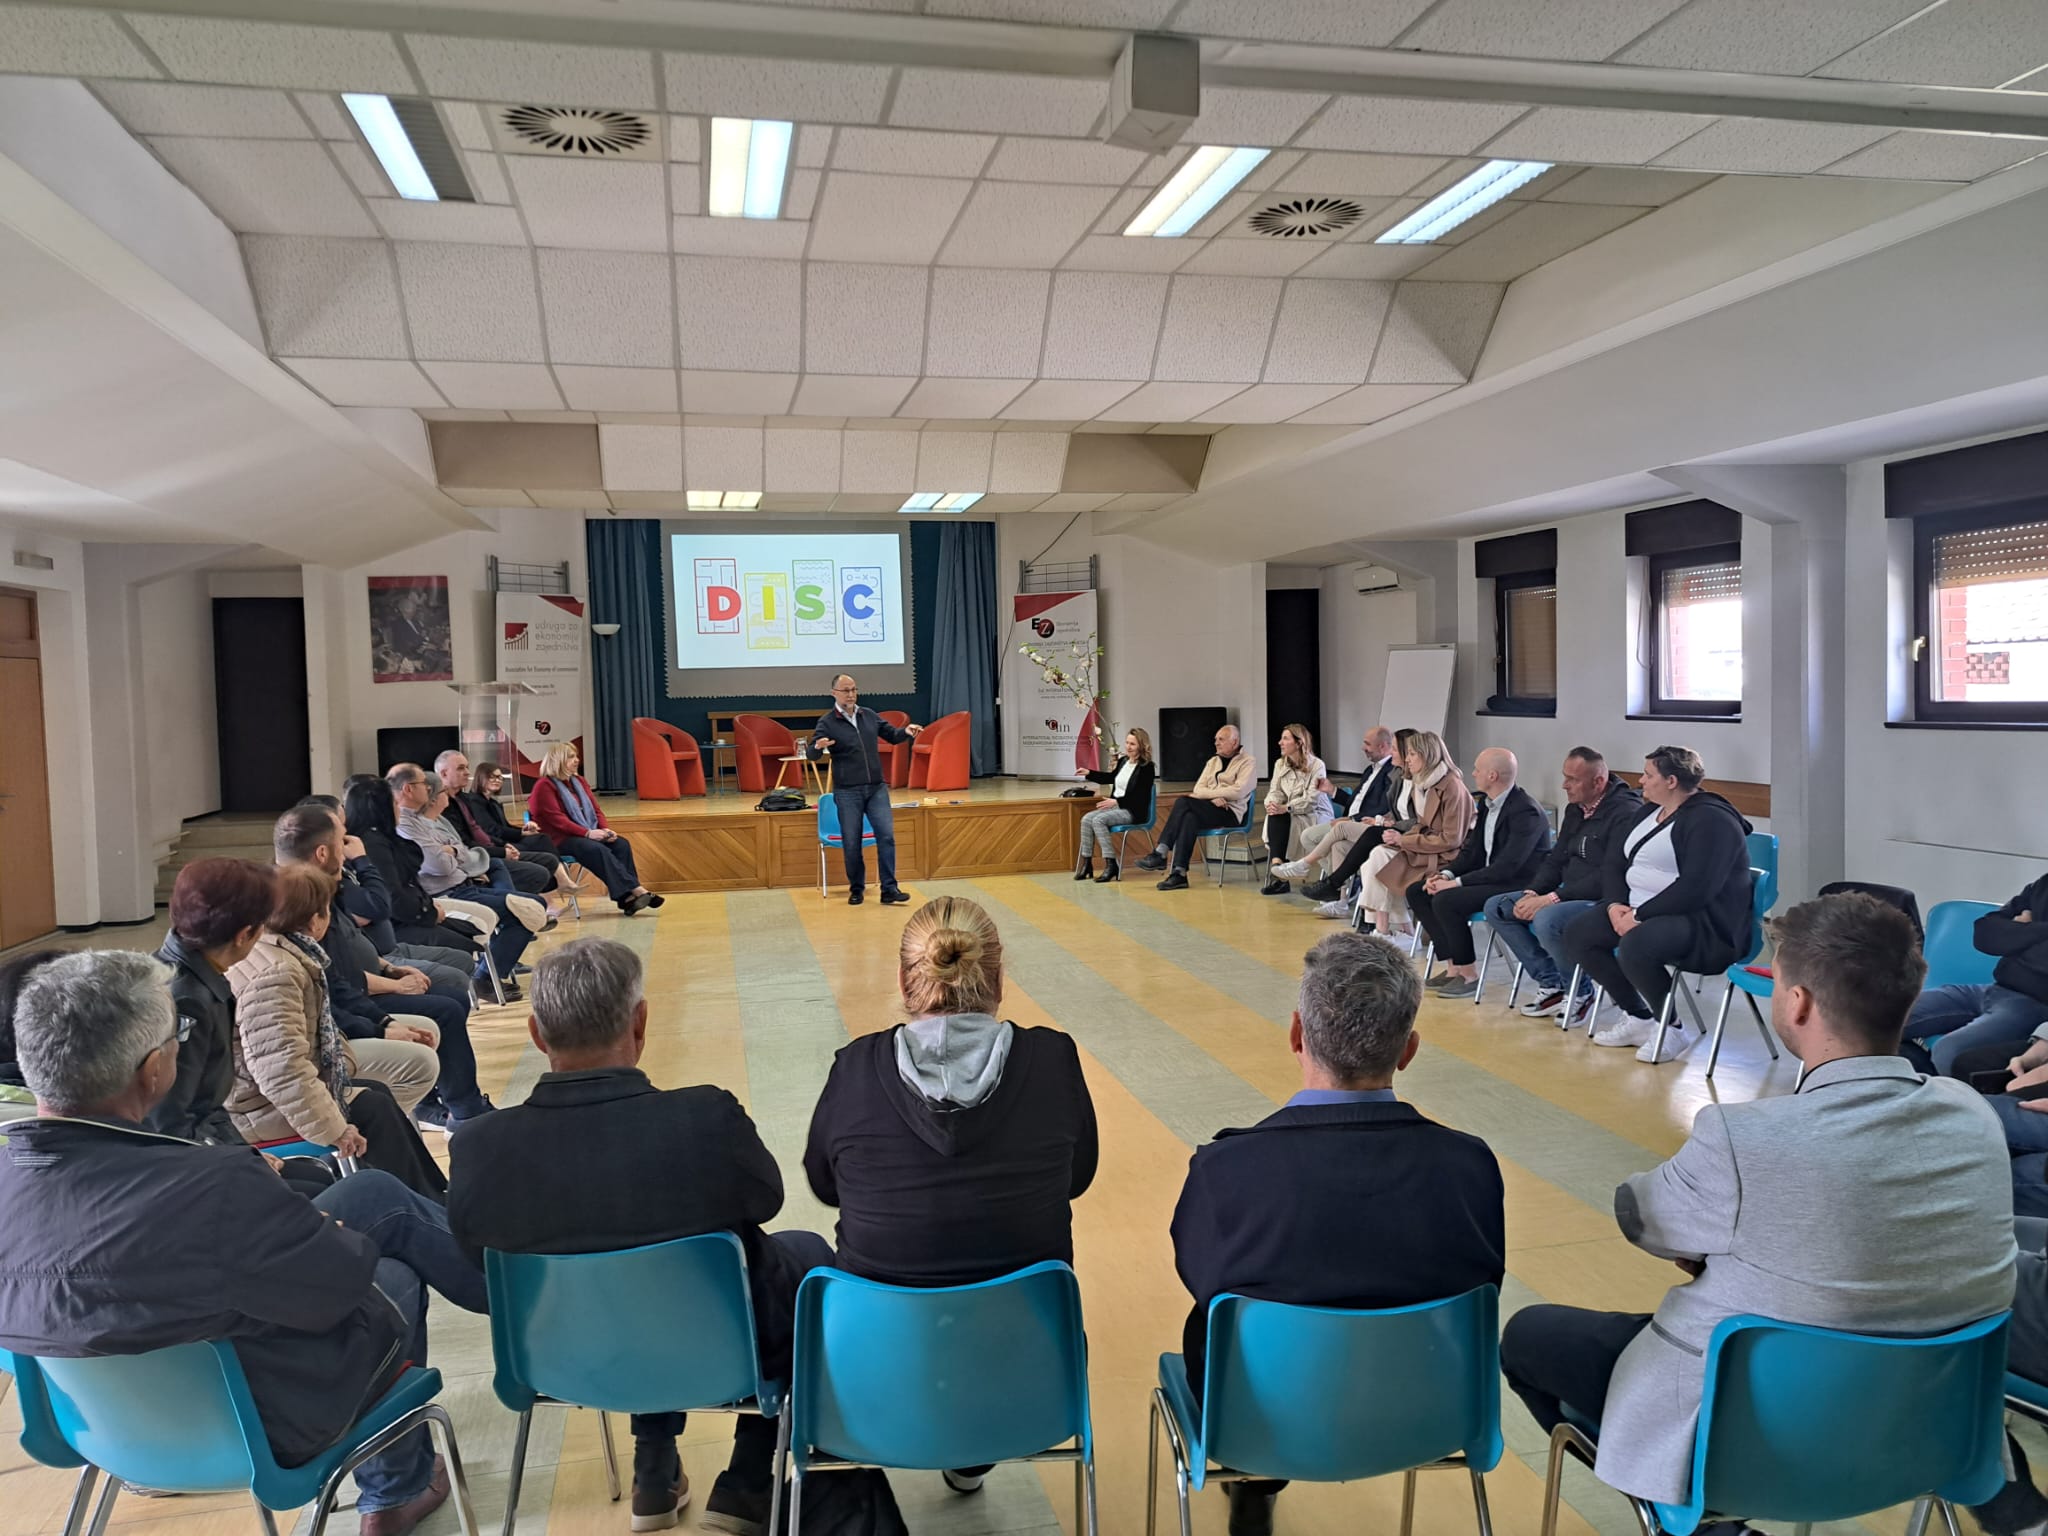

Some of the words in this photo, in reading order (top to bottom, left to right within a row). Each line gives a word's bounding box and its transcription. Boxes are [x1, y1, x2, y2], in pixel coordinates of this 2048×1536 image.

[706, 584, 875, 621] DISC
[535, 619, 566, 632] udruga
[568, 623, 578, 631] za
[535, 631, 579, 643] ekonomiju
